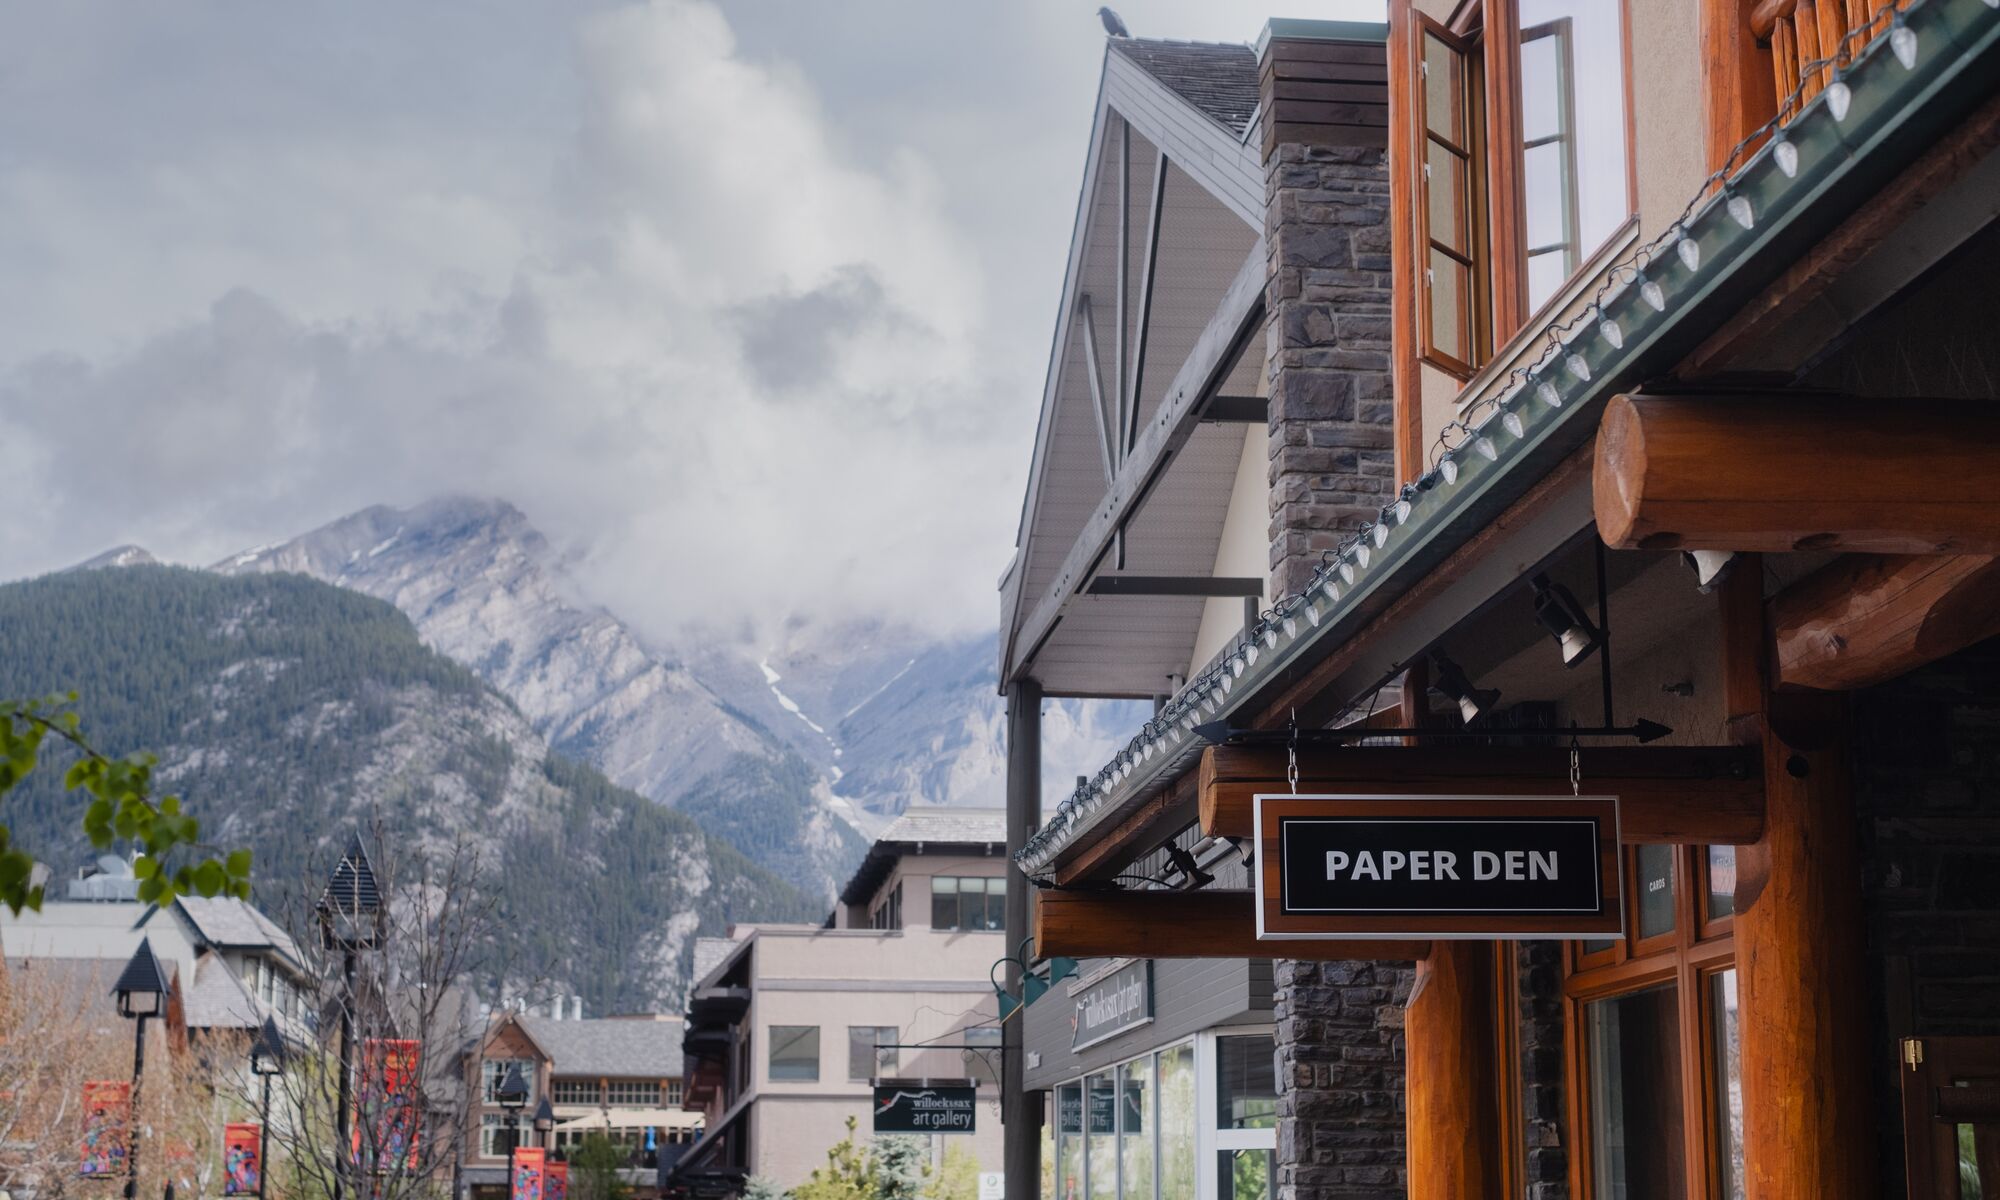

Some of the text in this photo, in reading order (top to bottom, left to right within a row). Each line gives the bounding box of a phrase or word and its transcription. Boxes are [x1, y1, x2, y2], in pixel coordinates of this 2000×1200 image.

[1326, 851, 1559, 881] PAPER DEN
[1649, 877, 1665, 892] CARDS
[912, 1109, 972, 1129] art gallery
